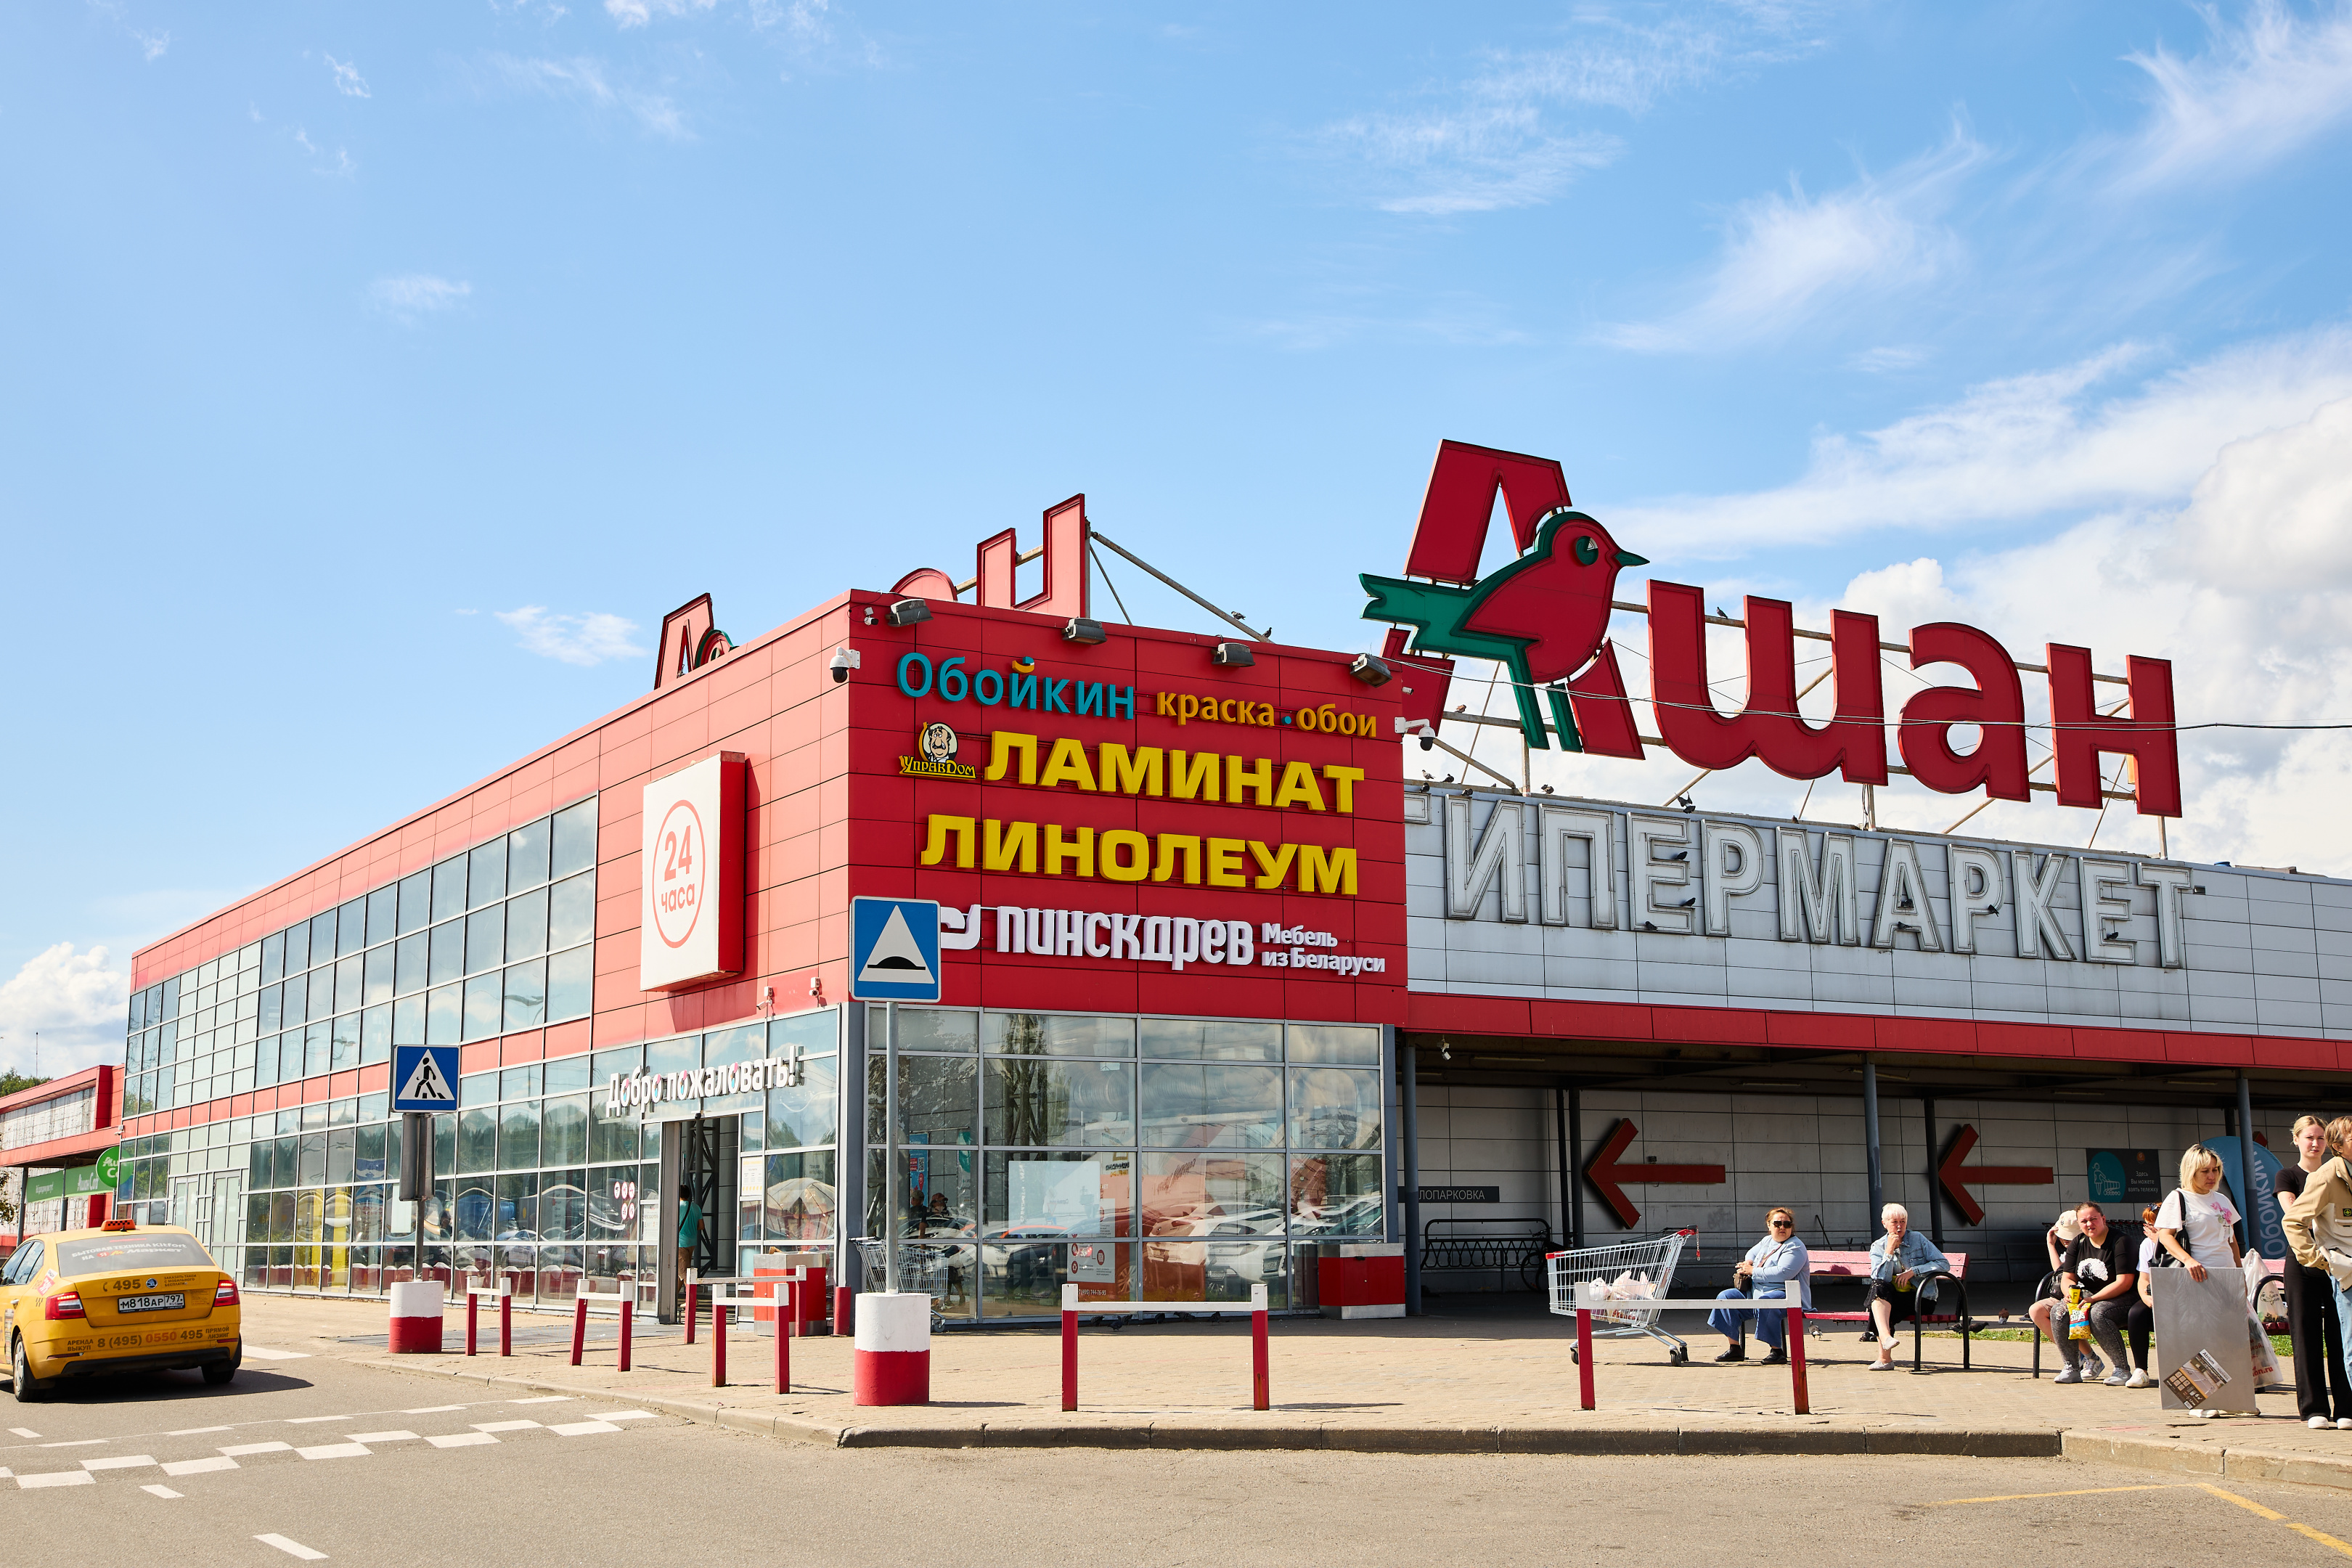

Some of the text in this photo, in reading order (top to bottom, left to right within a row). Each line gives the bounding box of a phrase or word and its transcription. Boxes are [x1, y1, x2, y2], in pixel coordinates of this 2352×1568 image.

[1381, 438, 2182, 817] Ашан
[897, 653, 1376, 738] Обойкин краска обои
[984, 730, 1364, 814] ЛАМИНАТ
[664, 825, 692, 882] 24
[920, 814, 1359, 895] ЛИНОЛЕУМ
[1405, 791, 2192, 968] ИПЕРМАРКЕТ
[661, 883, 695, 913] часа
[1262, 922, 1338, 947] Мебель
[1262, 947, 1385, 976] из Беларуси
[606, 1045, 796, 1118] Добро пожаловать!
[1418, 1190, 1485, 1200] ЛОПАРКОВКА
[72, 1245, 113, 1258] БЫТОВАЯ
[113, 1243, 152, 1251] ТЕХНИКА
[113, 1278, 141, 1291] 495
[122, 1297, 164, 1309] М818АР
[165, 1294, 181, 1303] 797
[97, 1329, 203, 1349] 8 (495) 0550 495
[205, 1326, 229, 1334] ПРЯМОЙ
[2202, 1352, 2215, 1365] Atrium
